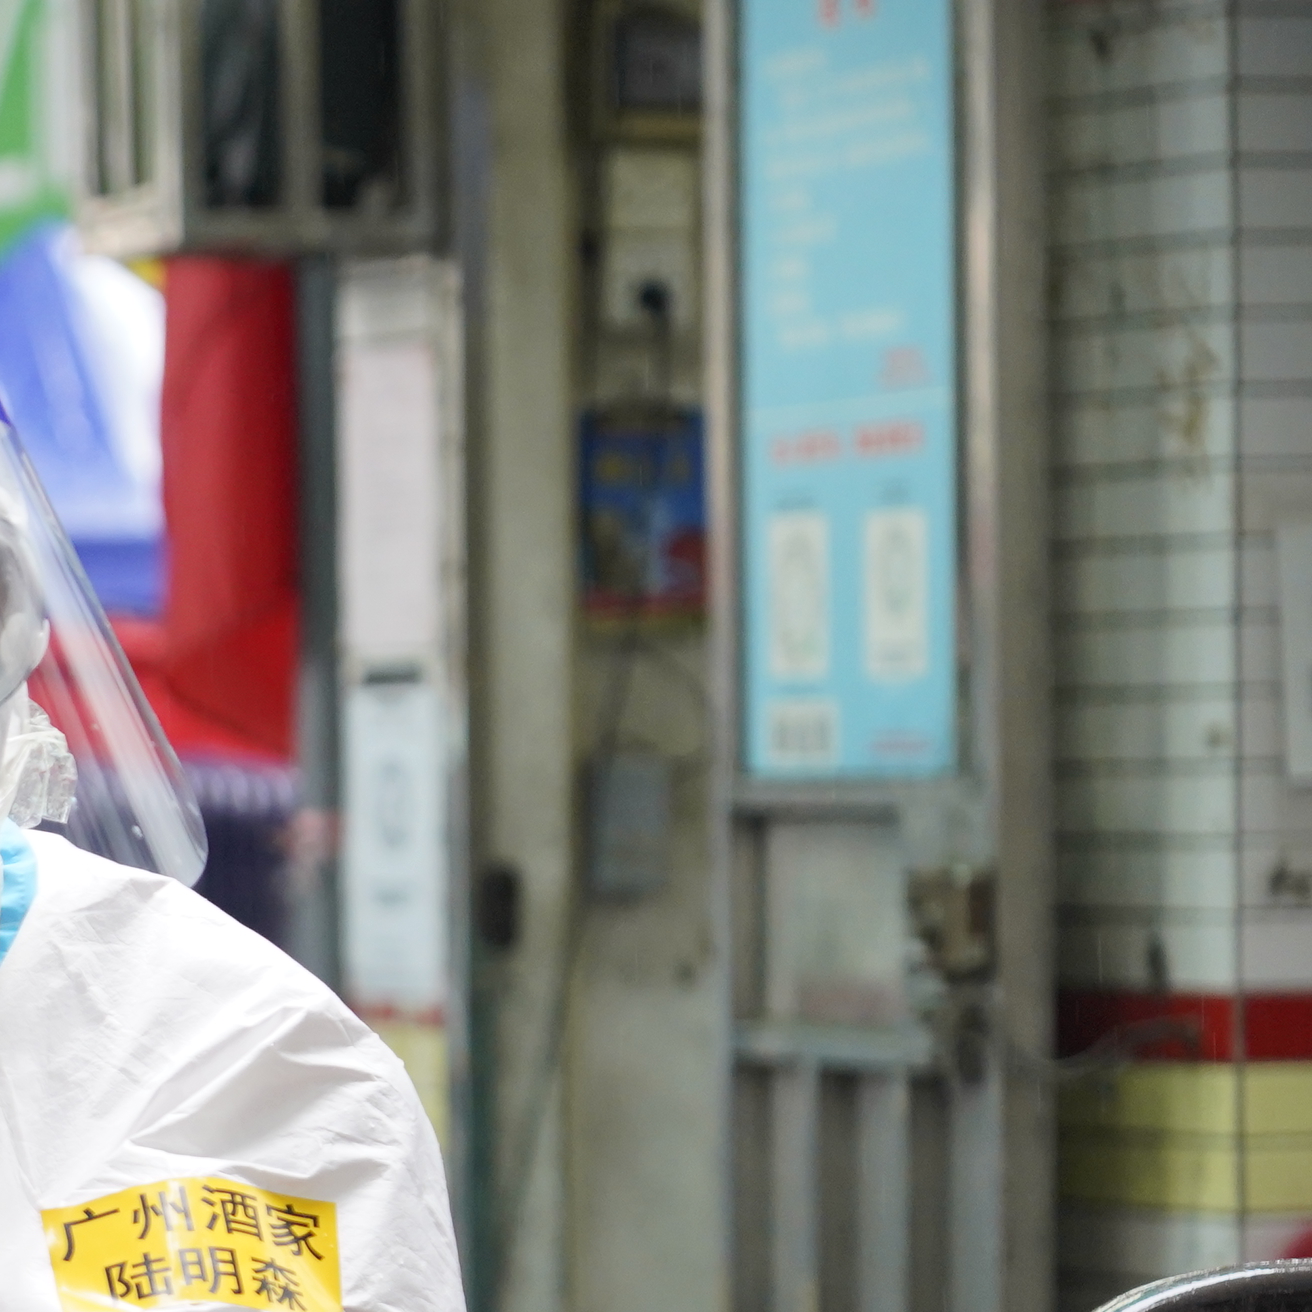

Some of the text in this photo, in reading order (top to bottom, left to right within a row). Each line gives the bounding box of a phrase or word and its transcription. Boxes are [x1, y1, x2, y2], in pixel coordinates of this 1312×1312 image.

[63, 1184, 325, 1263] 广州酒家
[104, 1246, 307, 1312] 陆明森
